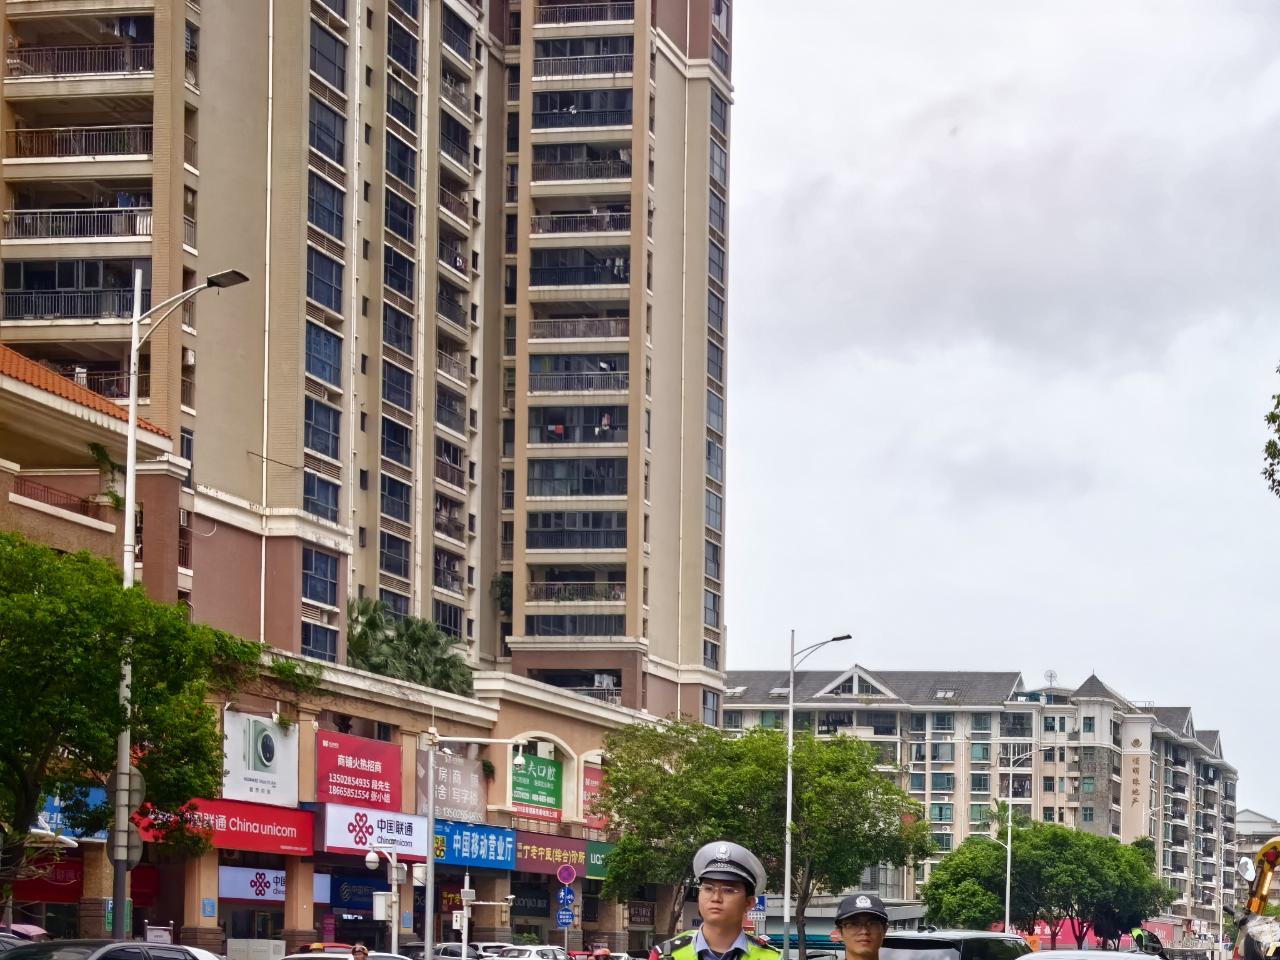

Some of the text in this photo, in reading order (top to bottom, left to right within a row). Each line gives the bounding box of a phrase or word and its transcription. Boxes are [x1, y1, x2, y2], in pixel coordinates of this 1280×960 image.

[337, 754, 382, 773] 商铺火热招商
[229, 817, 260, 833] China
[260, 822, 297, 838] unicom
[377, 819, 413, 836] 中国联通
[453, 830, 514, 861] 中国移动营业厅
